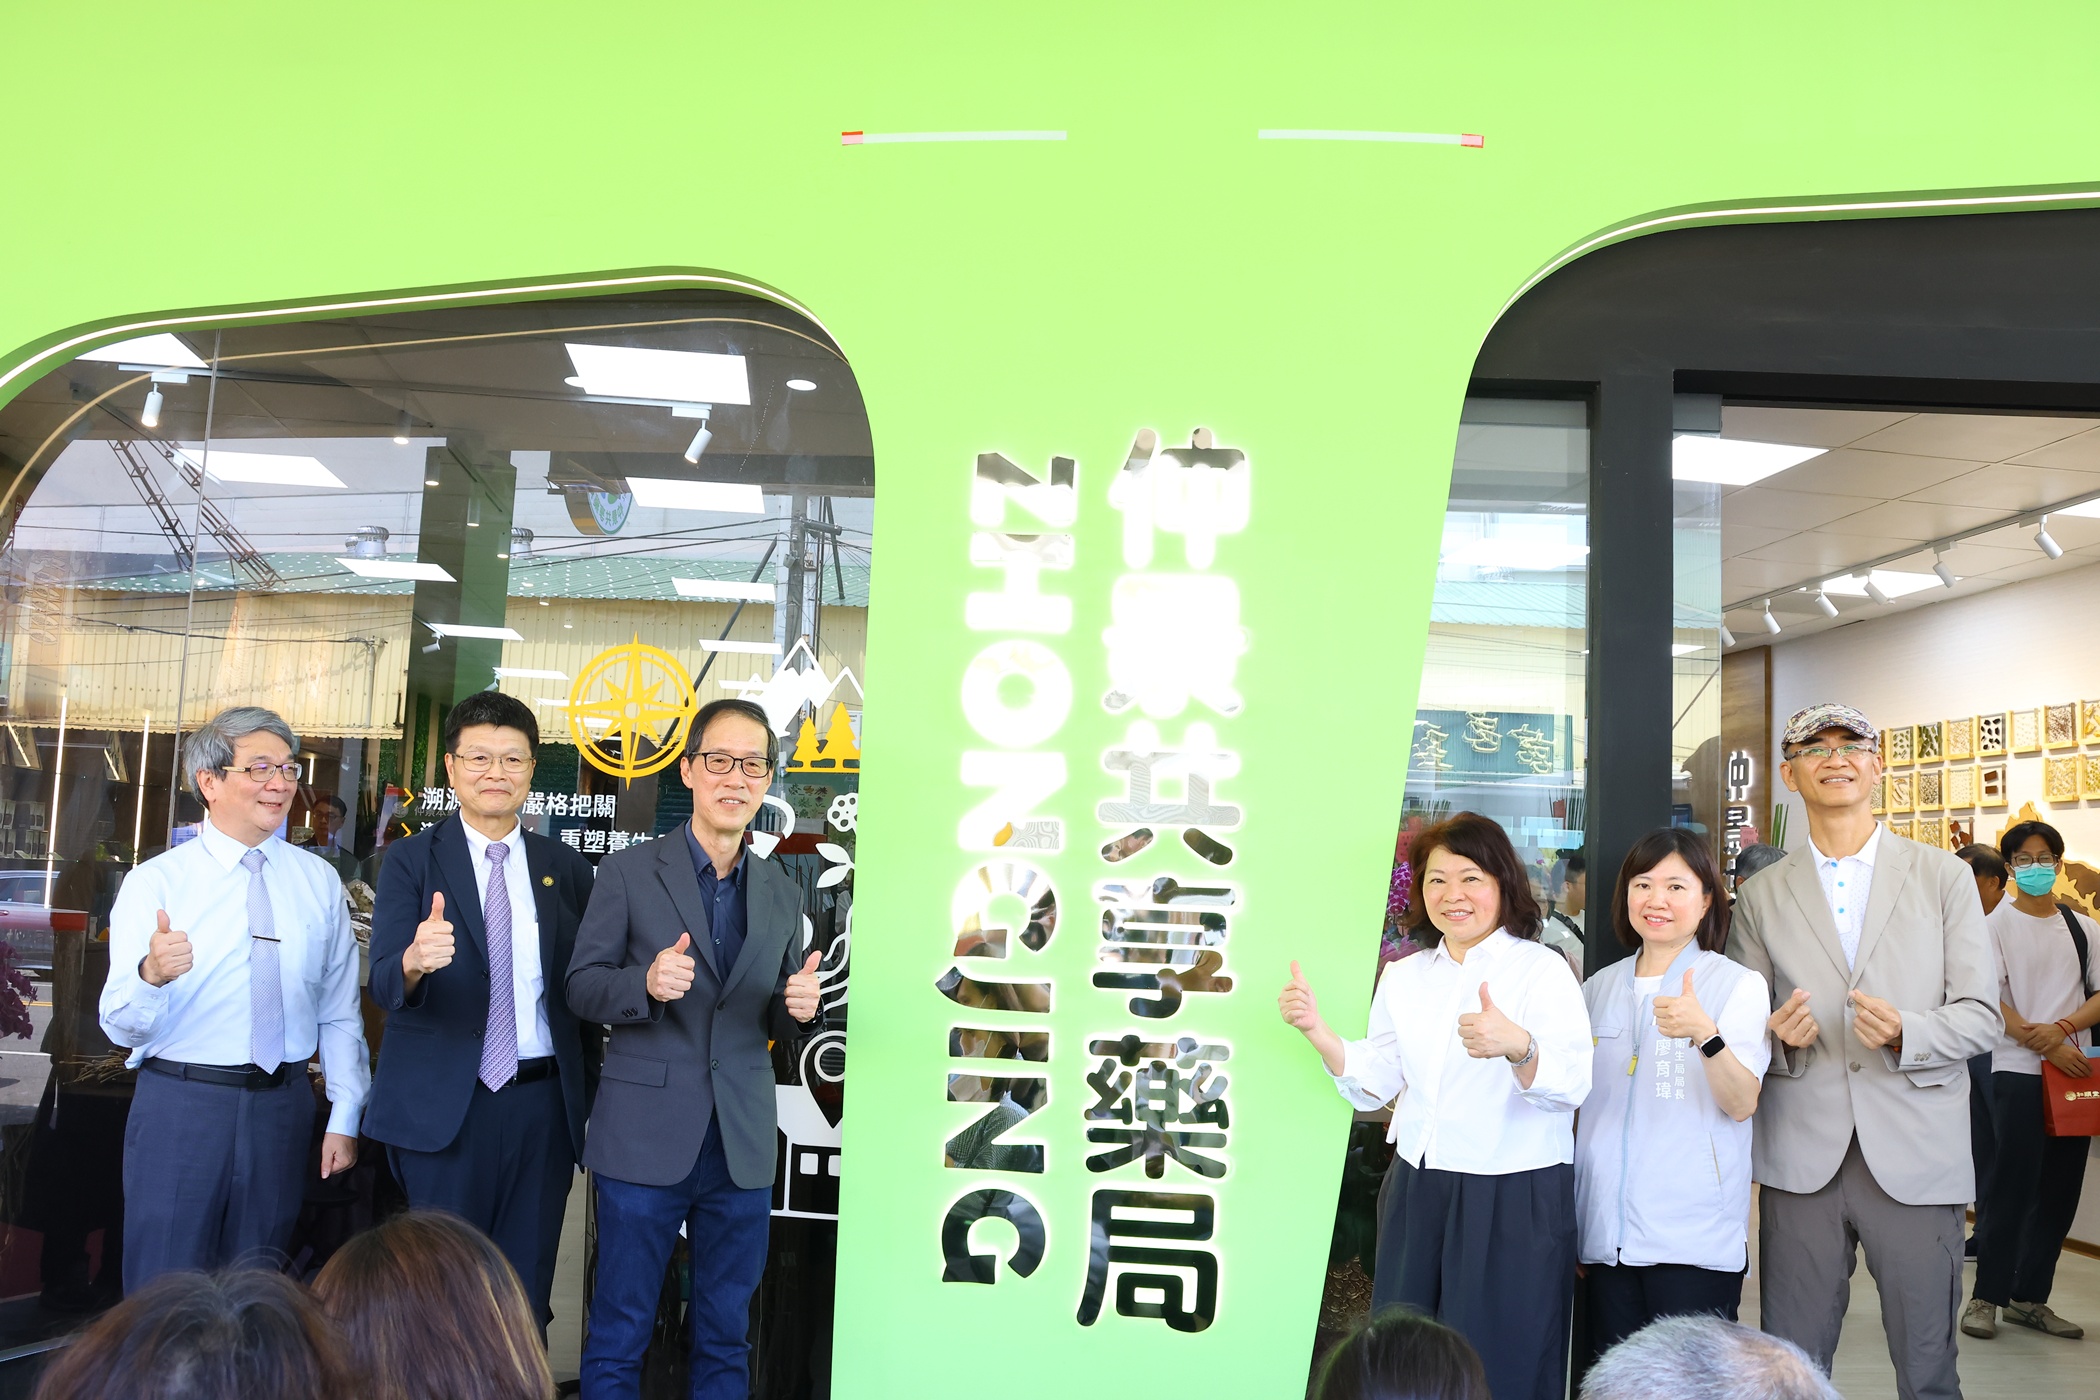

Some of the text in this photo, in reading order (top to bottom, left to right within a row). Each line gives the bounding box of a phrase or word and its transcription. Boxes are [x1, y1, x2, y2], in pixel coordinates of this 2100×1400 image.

[522, 792, 617, 818] 嚴格把關
[937, 452, 1076, 1286] ZHONGJING
